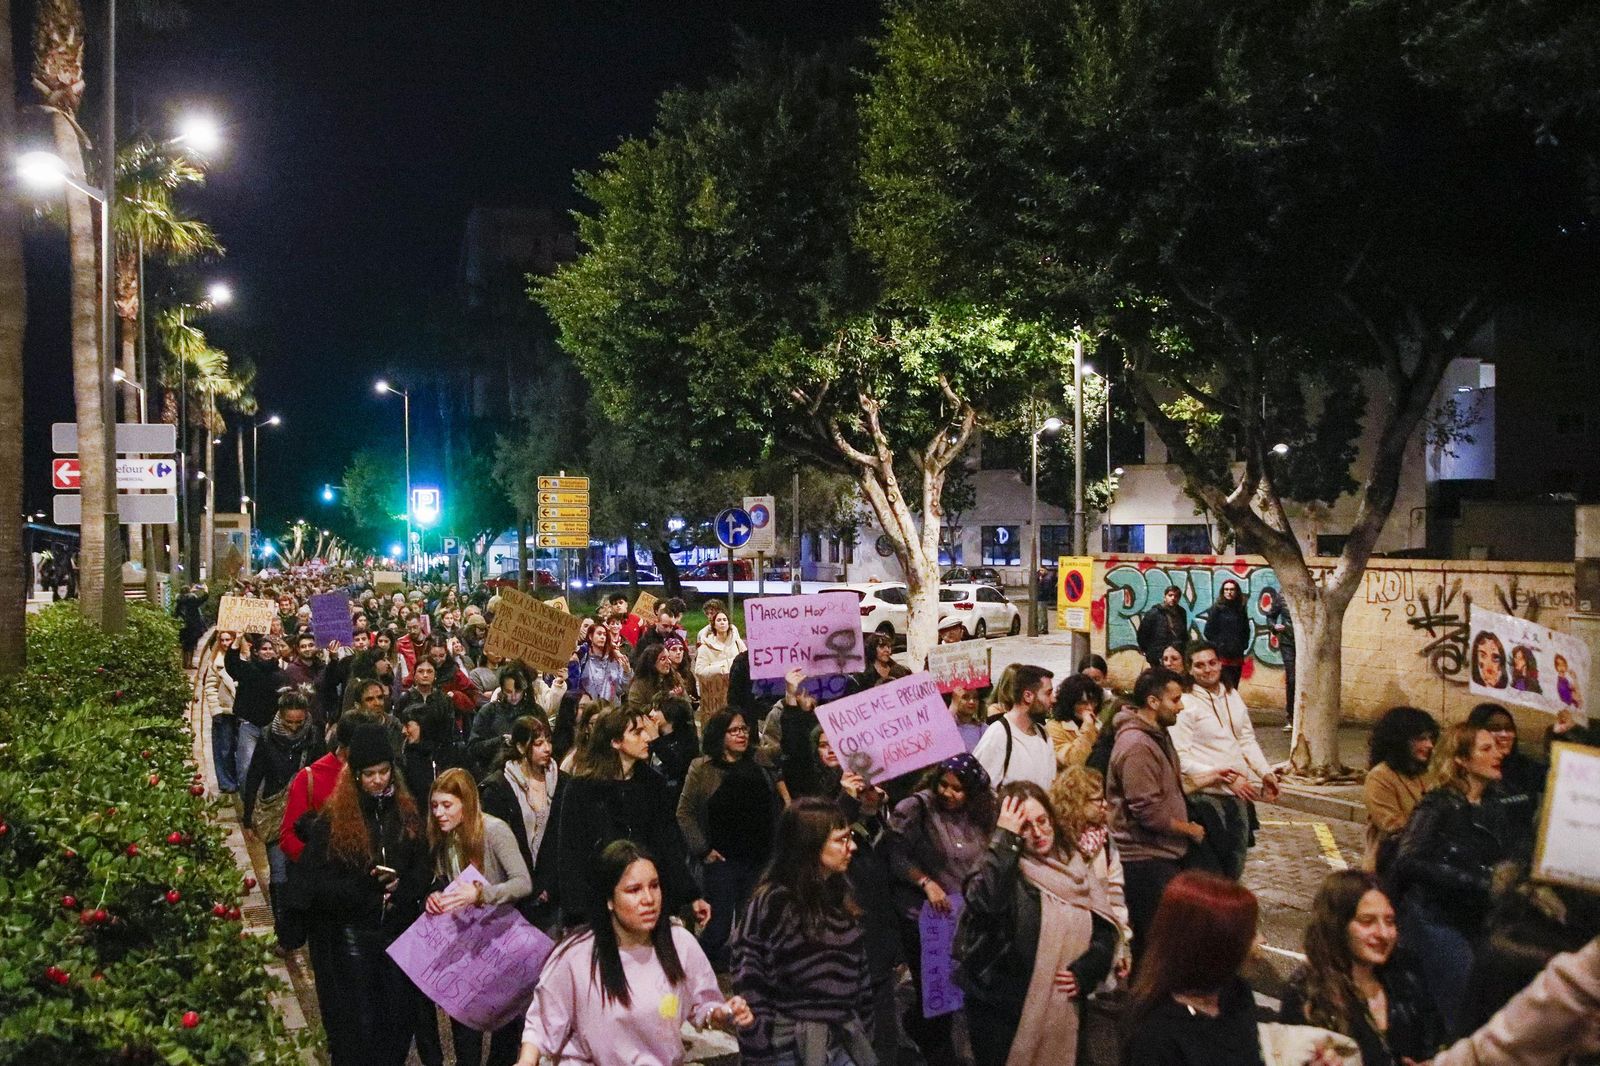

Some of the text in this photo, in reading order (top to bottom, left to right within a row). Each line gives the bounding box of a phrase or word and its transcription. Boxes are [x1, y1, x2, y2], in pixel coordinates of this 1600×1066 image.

[116, 464, 144, 473] efour
[444, 538, 456, 553] P
[500, 604, 566, 639] POR INSTAGRAM
[750, 604, 798, 621] MARCHO
[811, 626, 828, 635] NO
[754, 642, 812, 666] ESTÁN
[828, 703, 871, 734] NADIE
[870, 695, 896, 712] ME
[838, 705, 930, 758] COMO VESTIA MI
[882, 730, 934, 770] AGRESOR
